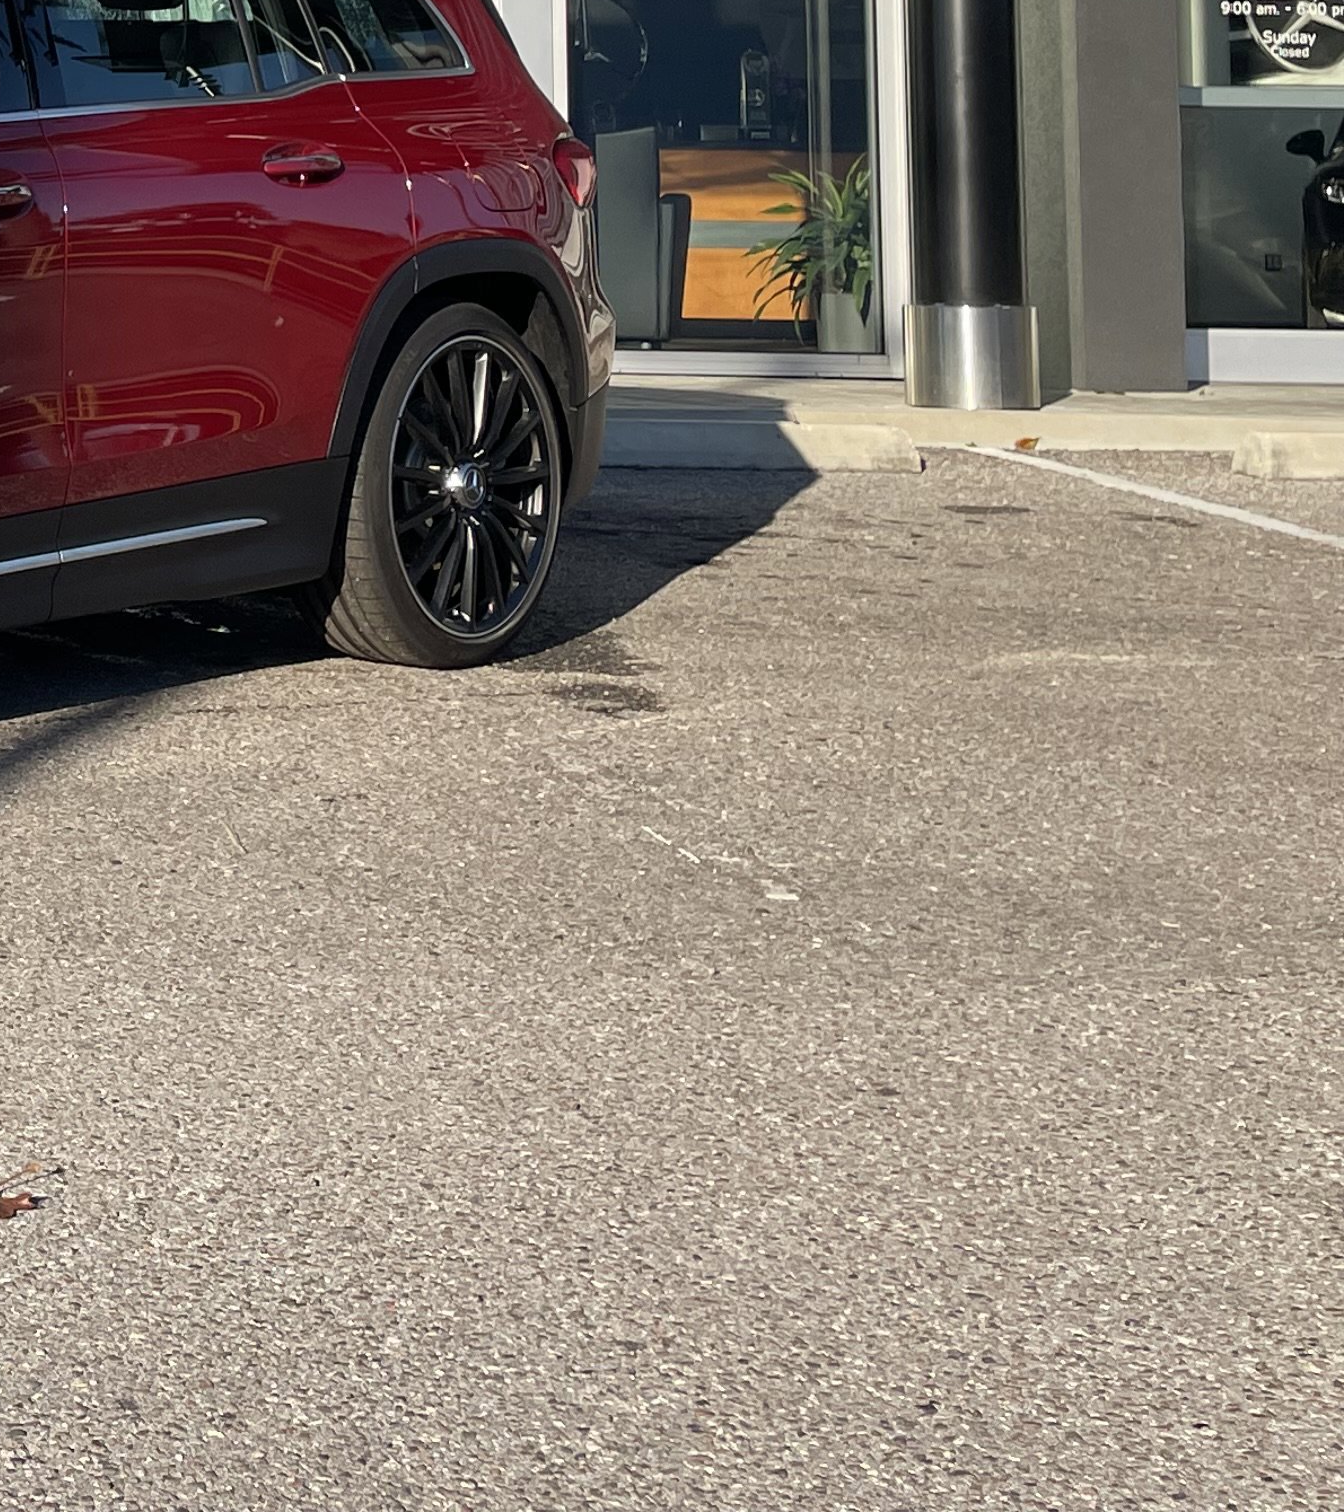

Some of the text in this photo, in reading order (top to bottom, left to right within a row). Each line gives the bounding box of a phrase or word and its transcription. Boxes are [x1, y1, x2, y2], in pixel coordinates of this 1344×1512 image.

[1220, 0, 1252, 15] 9:00
[1262, 29, 1317, 48] Sunday
[1271, 44, 1310, 58] Closed
